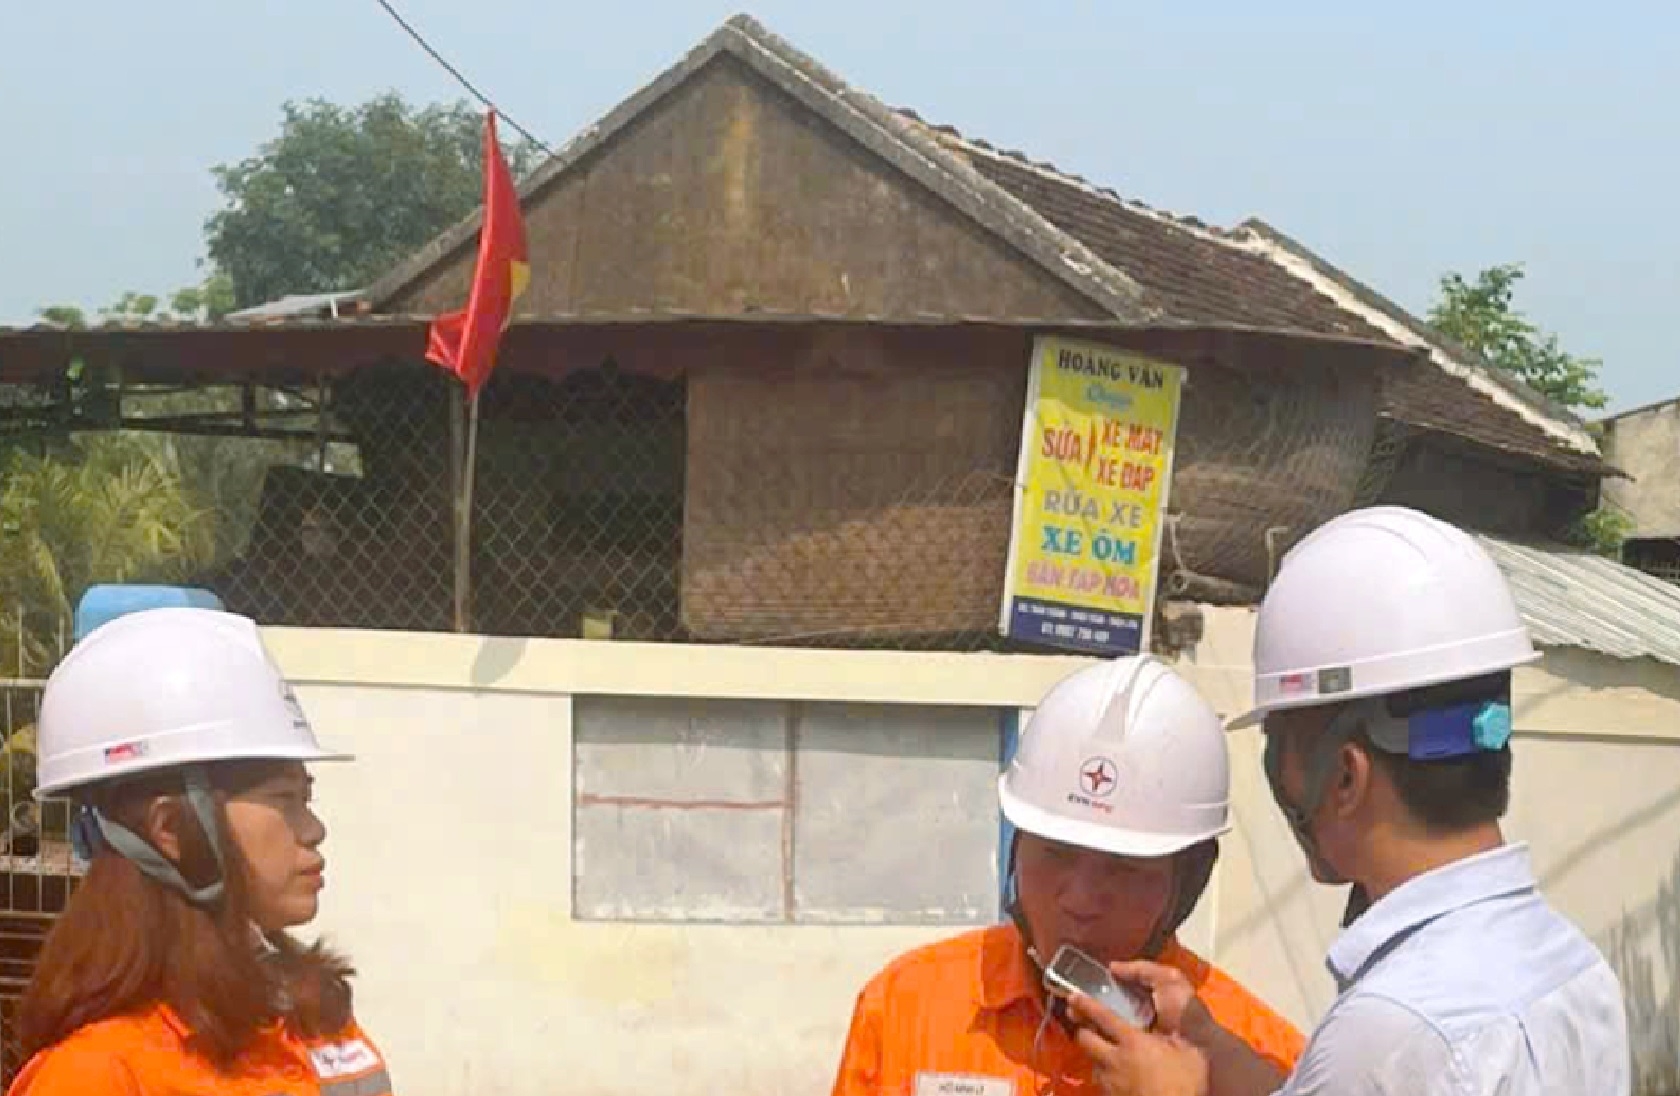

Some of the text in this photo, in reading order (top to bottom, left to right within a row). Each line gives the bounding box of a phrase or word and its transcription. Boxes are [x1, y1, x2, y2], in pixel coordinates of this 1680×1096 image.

[1101, 419, 1120, 448] XE
[1097, 457, 1118, 486] XE
[1110, 500, 1142, 529] XE
[1041, 525, 1136, 565] XE ÔM
